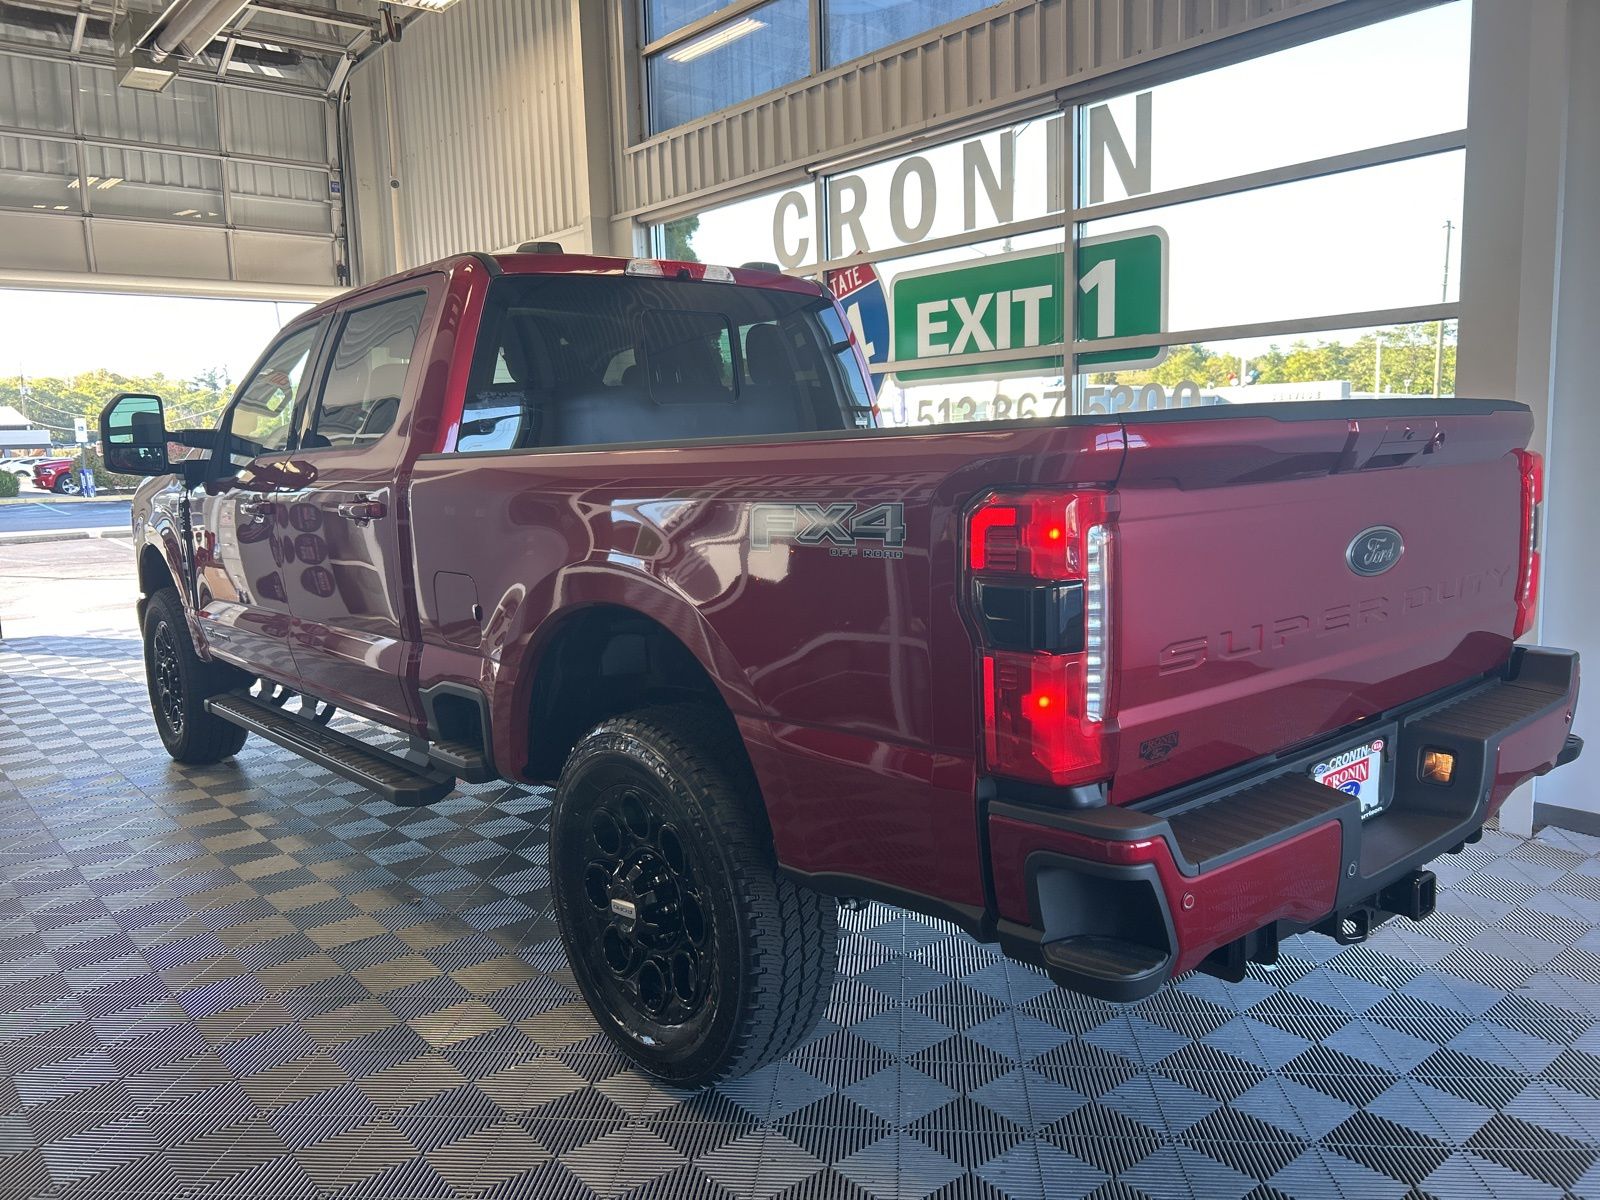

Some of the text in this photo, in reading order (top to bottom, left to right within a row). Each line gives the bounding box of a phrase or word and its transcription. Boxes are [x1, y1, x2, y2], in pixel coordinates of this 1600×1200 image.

[773, 91, 1153, 268] CRONIN
[917, 259, 1117, 358] EXIT 1
[750, 502, 907, 552] FX4
[1363, 537, 1394, 566] Ford
[829, 547, 904, 560] OFF ROAD
[1158, 565, 1512, 678] SUPER DUTY
[1329, 745, 1369, 769] CRONIN
